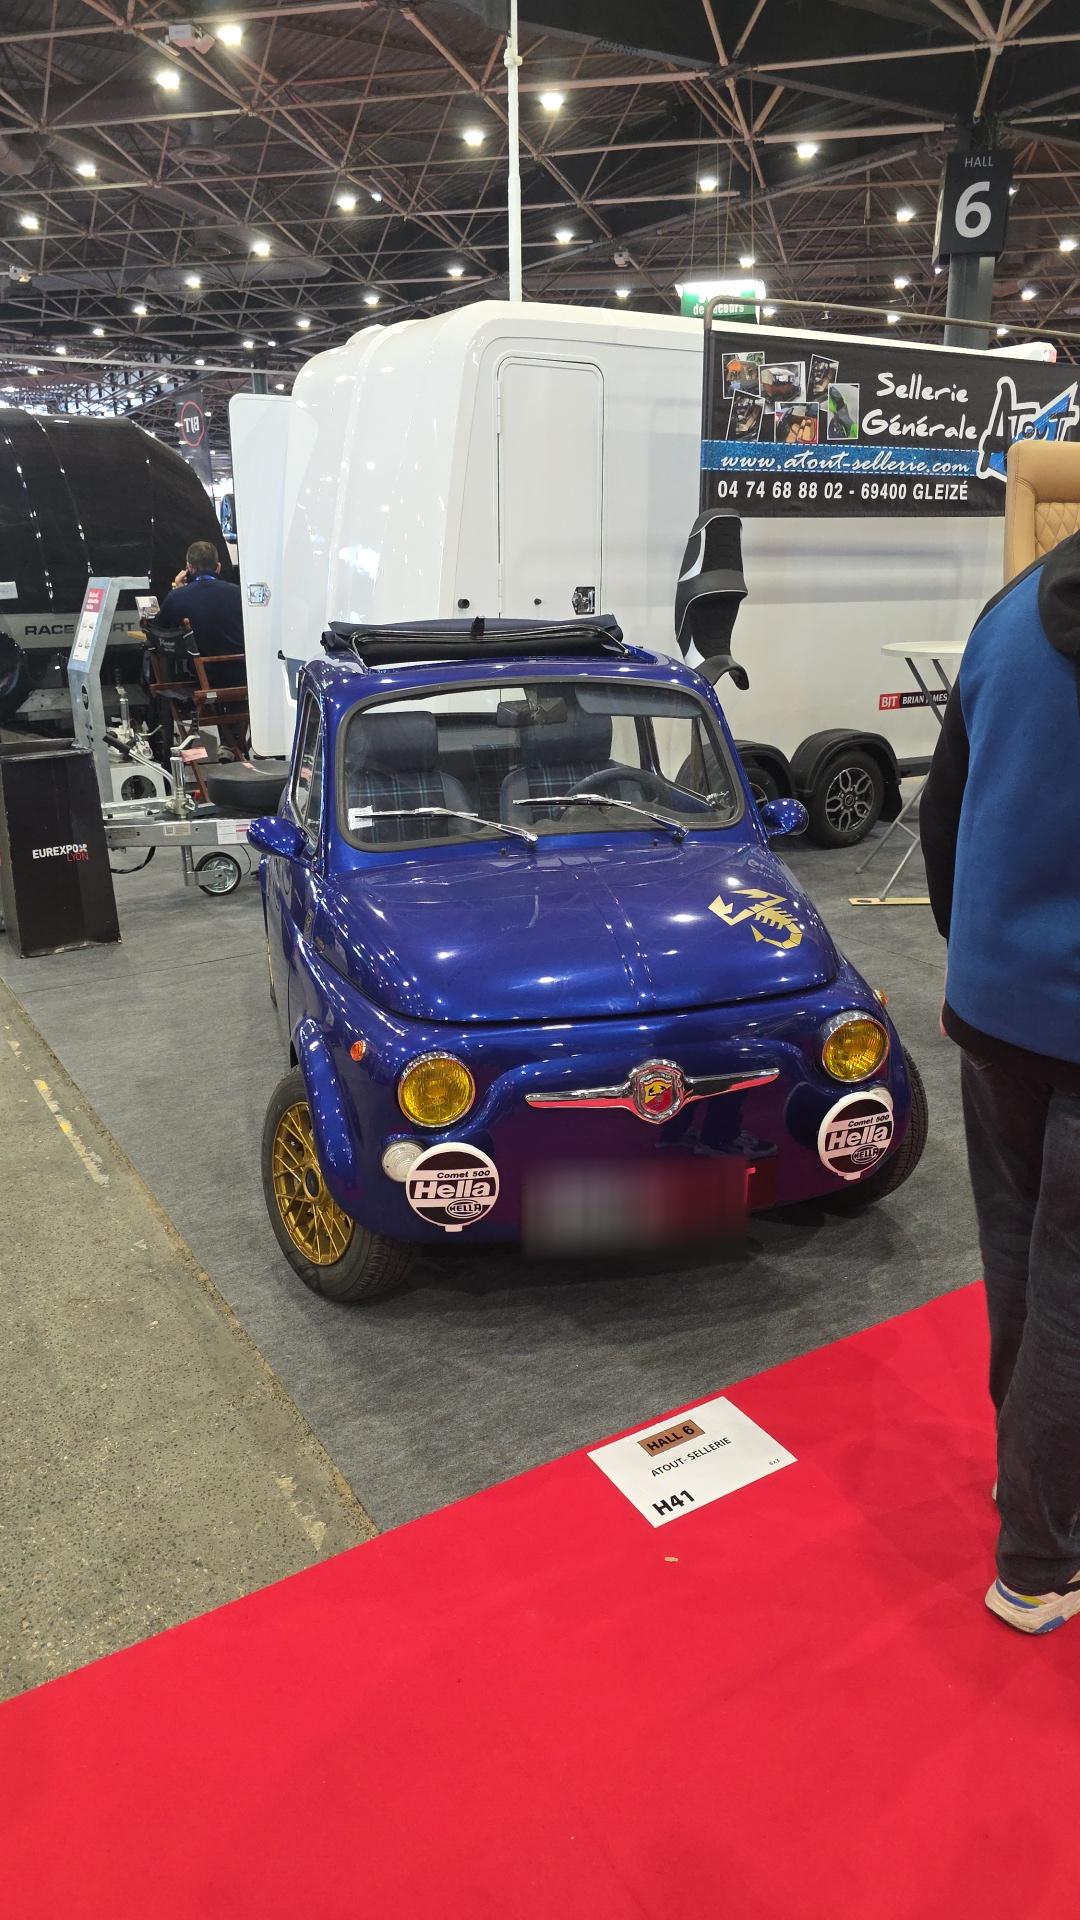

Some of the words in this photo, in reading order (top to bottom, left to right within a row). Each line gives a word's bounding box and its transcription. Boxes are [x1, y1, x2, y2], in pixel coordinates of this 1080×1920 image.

[964, 156, 995, 168] HALL
[955, 181, 992, 238] 6
[693, 303, 704, 315] de
[712, 304, 745, 315] ecours
[876, 372, 969, 403] Sellerie
[861, 408, 978, 440] Générale
[720, 450, 970, 474] www.atout-sellerie.com
[717, 480, 738, 498] 04
[746, 481, 765, 498] 74
[772, 481, 792, 499] 68
[798, 481, 818, 499] 88
[824, 482, 843, 499] 02
[861, 482, 907, 500] 69400
[912, 480, 968, 500] GLEIZÉ
[25, 624, 75, 635] RACE
[902, 695, 925, 705] BRIAN
[926, 693, 948, 705] MES
[32, 844, 79, 859] EUREXPO
[66, 852, 89, 861] LYON
[847, 1116, 874, 1127] Comet
[875, 1114, 890, 1123] 500
[828, 1125, 889, 1151] Hella
[853, 1147, 880, 1160] HELLA
[436, 1171, 469, 1179] Comet
[413, 1180, 491, 1199] Hella
[449, 1203, 482, 1212] HELLA
[646, 1432, 684, 1451] HALL
[682, 1425, 695, 1435] 6
[687, 1437, 732, 1461] SELLERIE
[652, 1490, 695, 1516] H41
